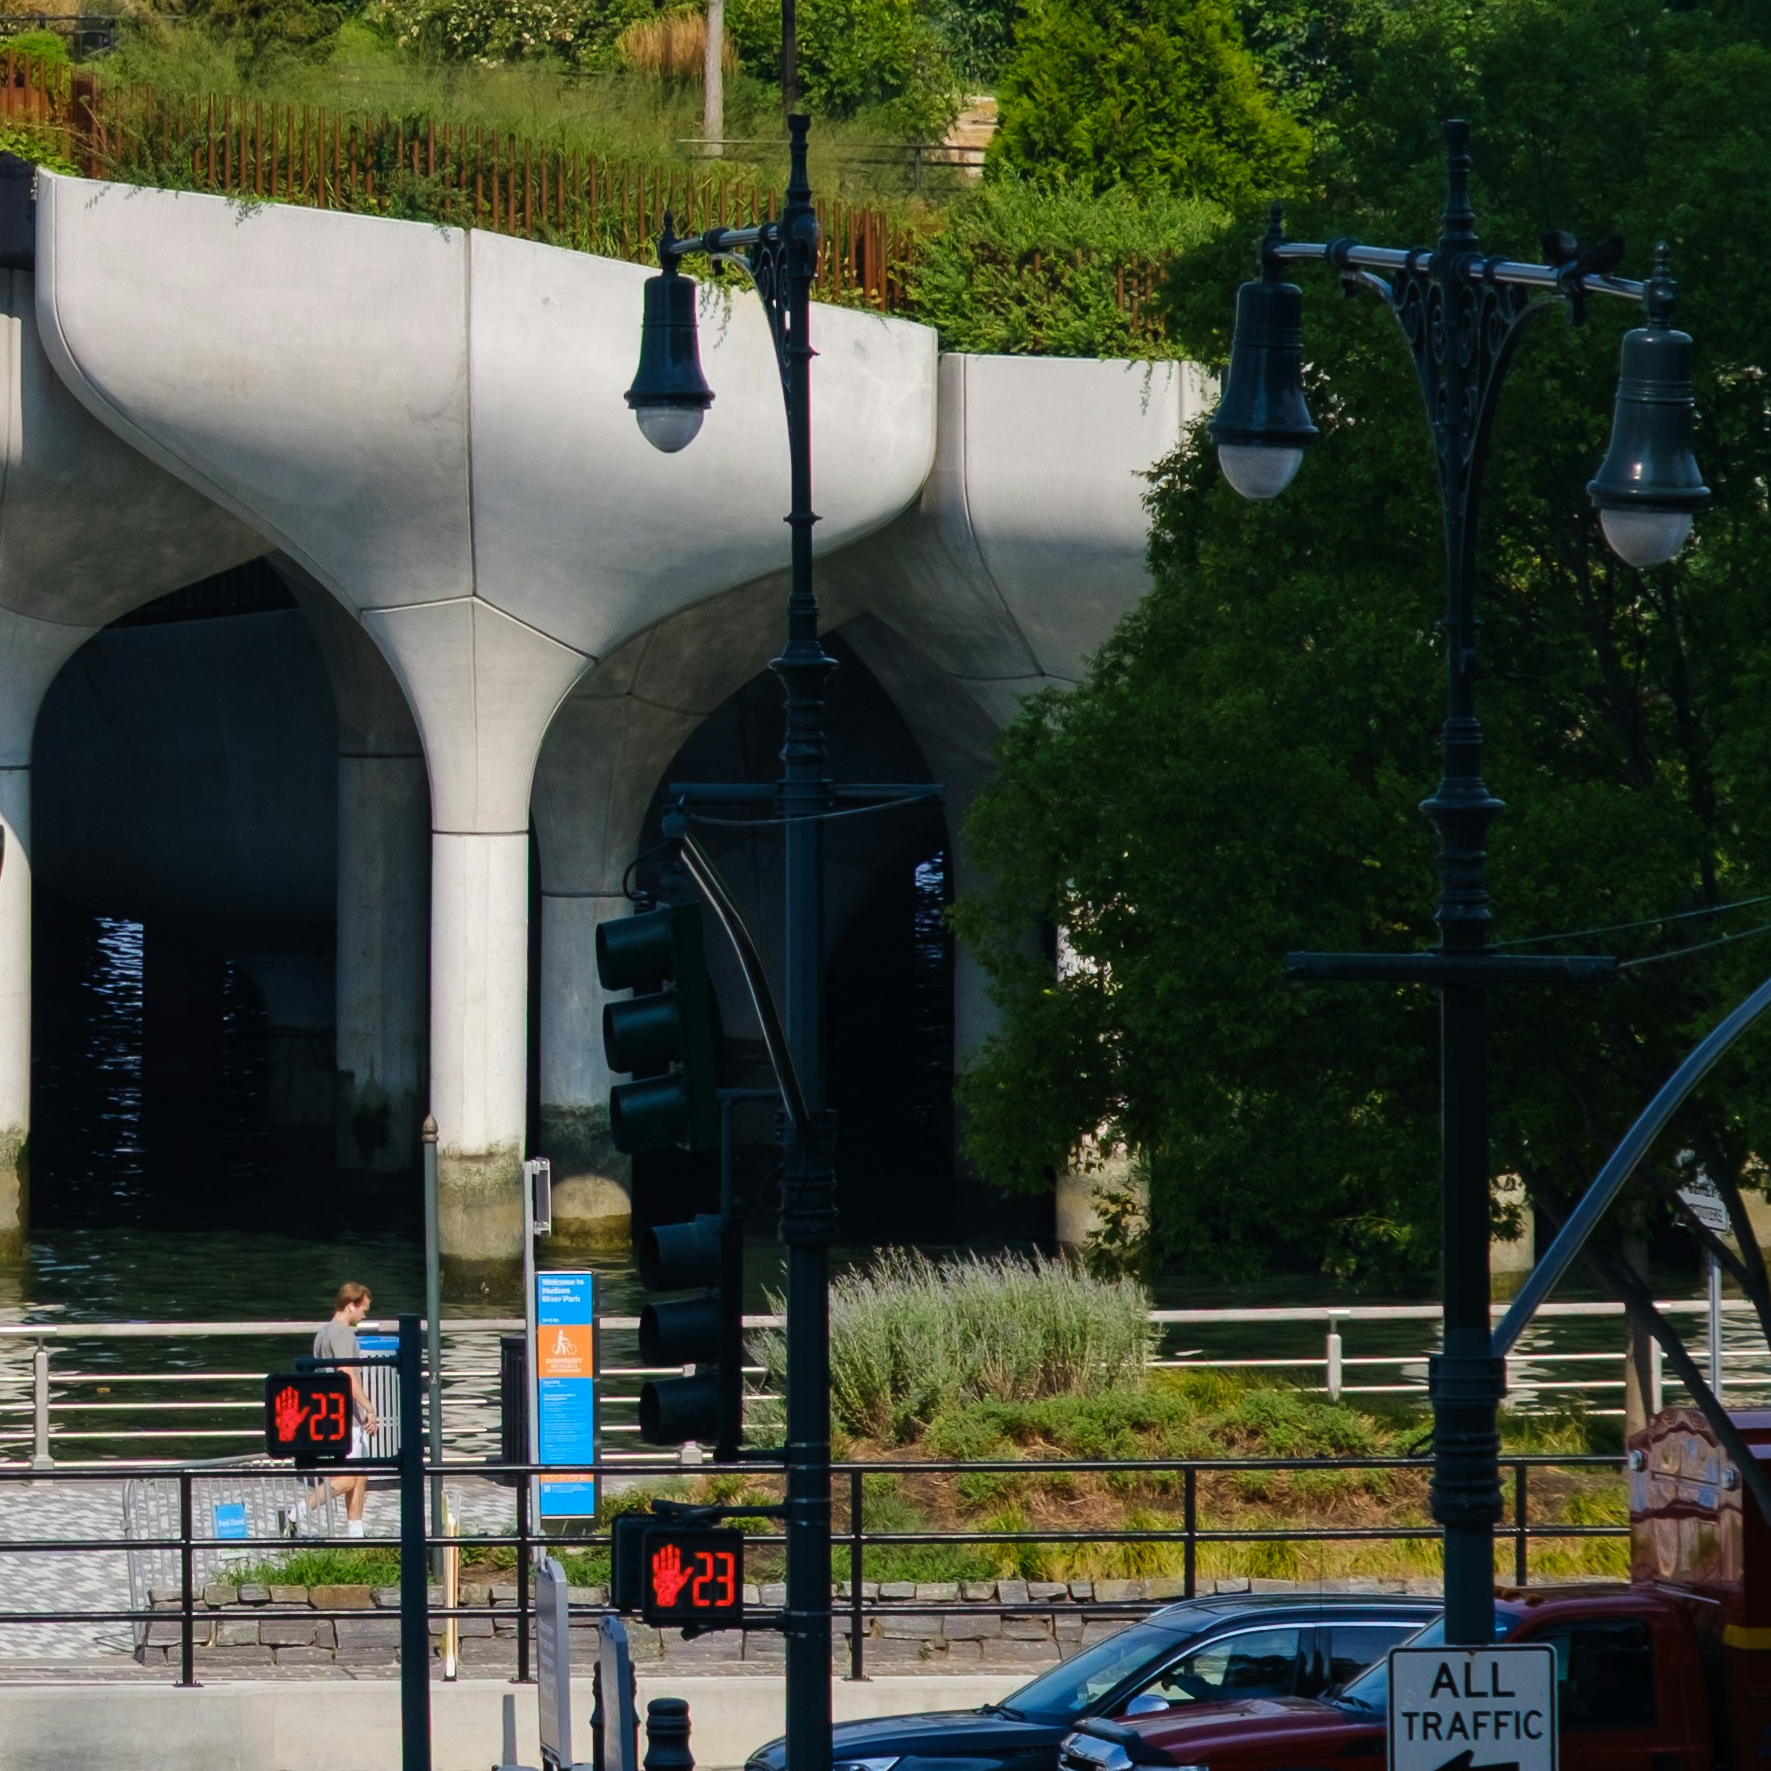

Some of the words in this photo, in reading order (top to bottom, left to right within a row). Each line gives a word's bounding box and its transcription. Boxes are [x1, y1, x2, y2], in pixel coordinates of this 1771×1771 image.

[309, 1392, 346, 1441] 23
[692, 1551, 735, 1607] 23
[1429, 1661, 1516, 1699] ALL
[1400, 1709, 1544, 1742] TRAFFIC
